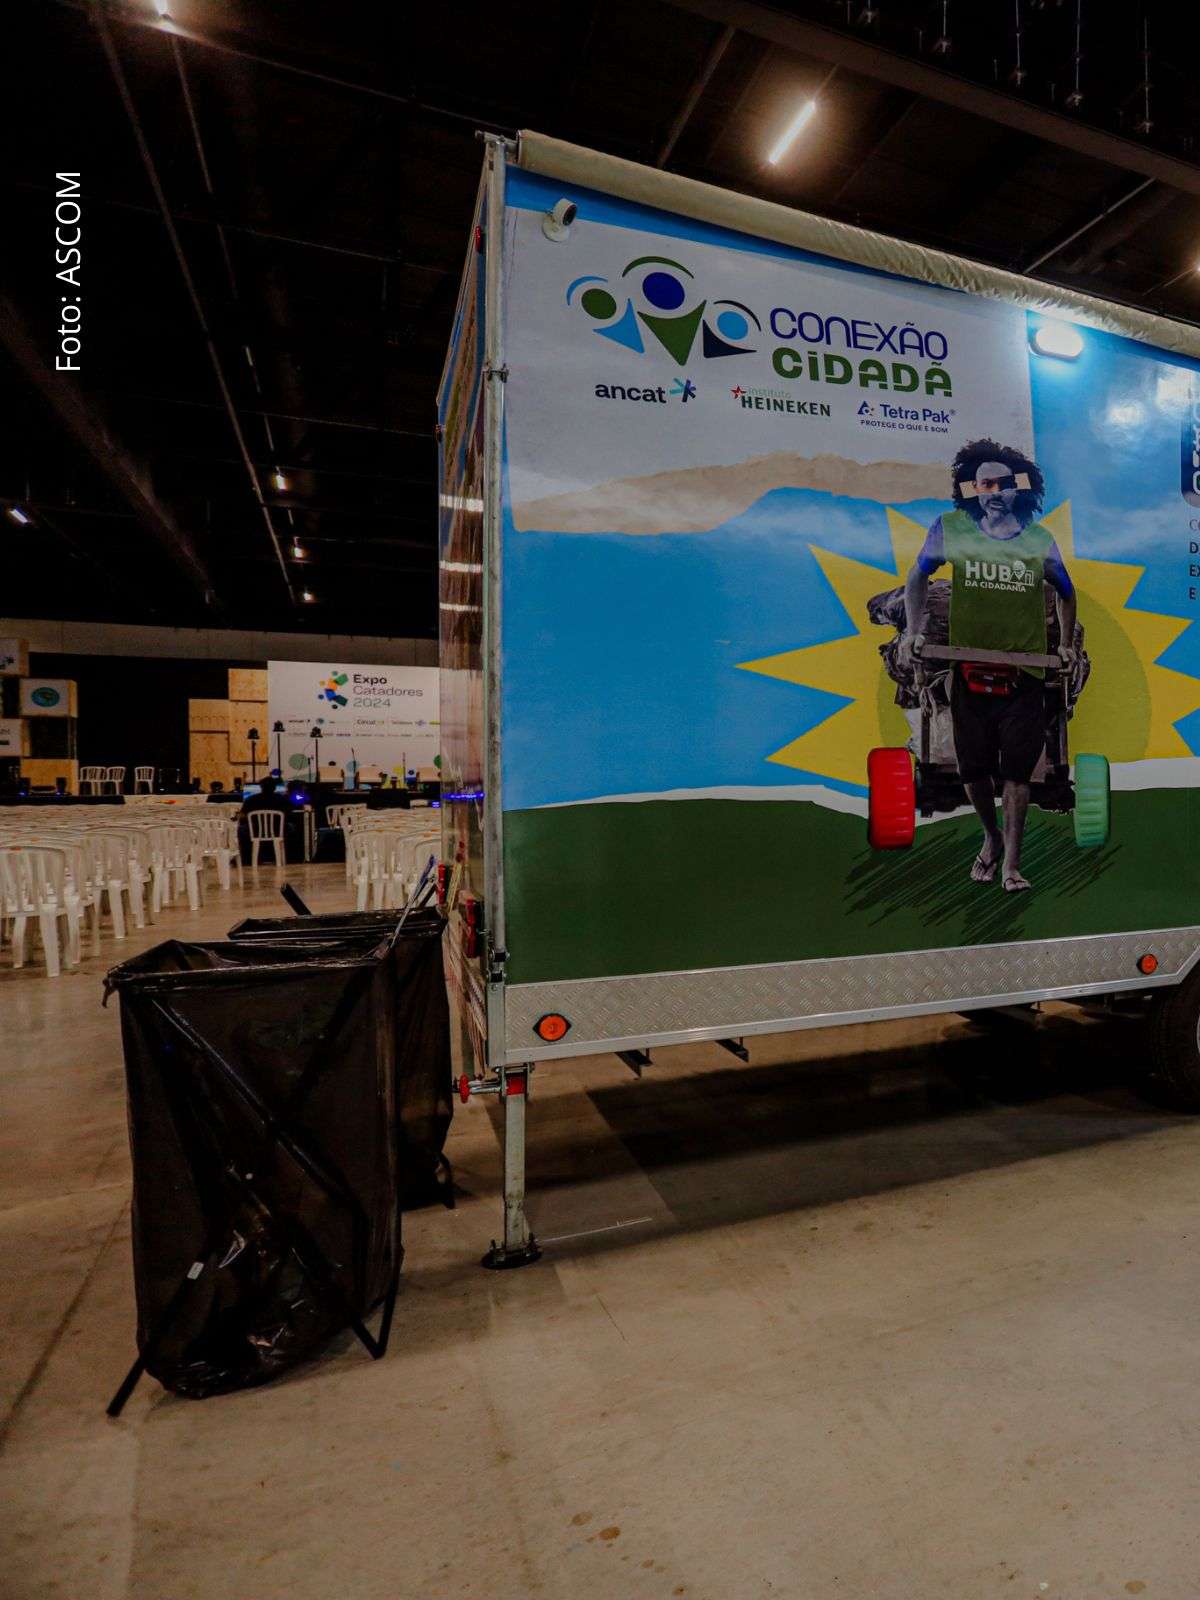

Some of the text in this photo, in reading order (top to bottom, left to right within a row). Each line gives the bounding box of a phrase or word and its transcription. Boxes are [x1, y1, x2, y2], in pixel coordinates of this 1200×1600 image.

[769, 307, 948, 361] CONEXÃO
[594, 383, 667, 404] ancat
[741, 395, 831, 417] HEINEKEN
[879, 403, 950, 424] Tetra Pak
[860, 419, 897, 430] PROTEGE
[906, 424, 921, 432] QUE
[965, 560, 1011, 582] HUB
[964, 579, 1027, 593] DA CIDADANIA
[1188, 586, 1197, 600] E
[353, 674, 388, 686] Expo
[353, 685, 424, 697] Catadores
[353, 697, 391, 708] 2024
